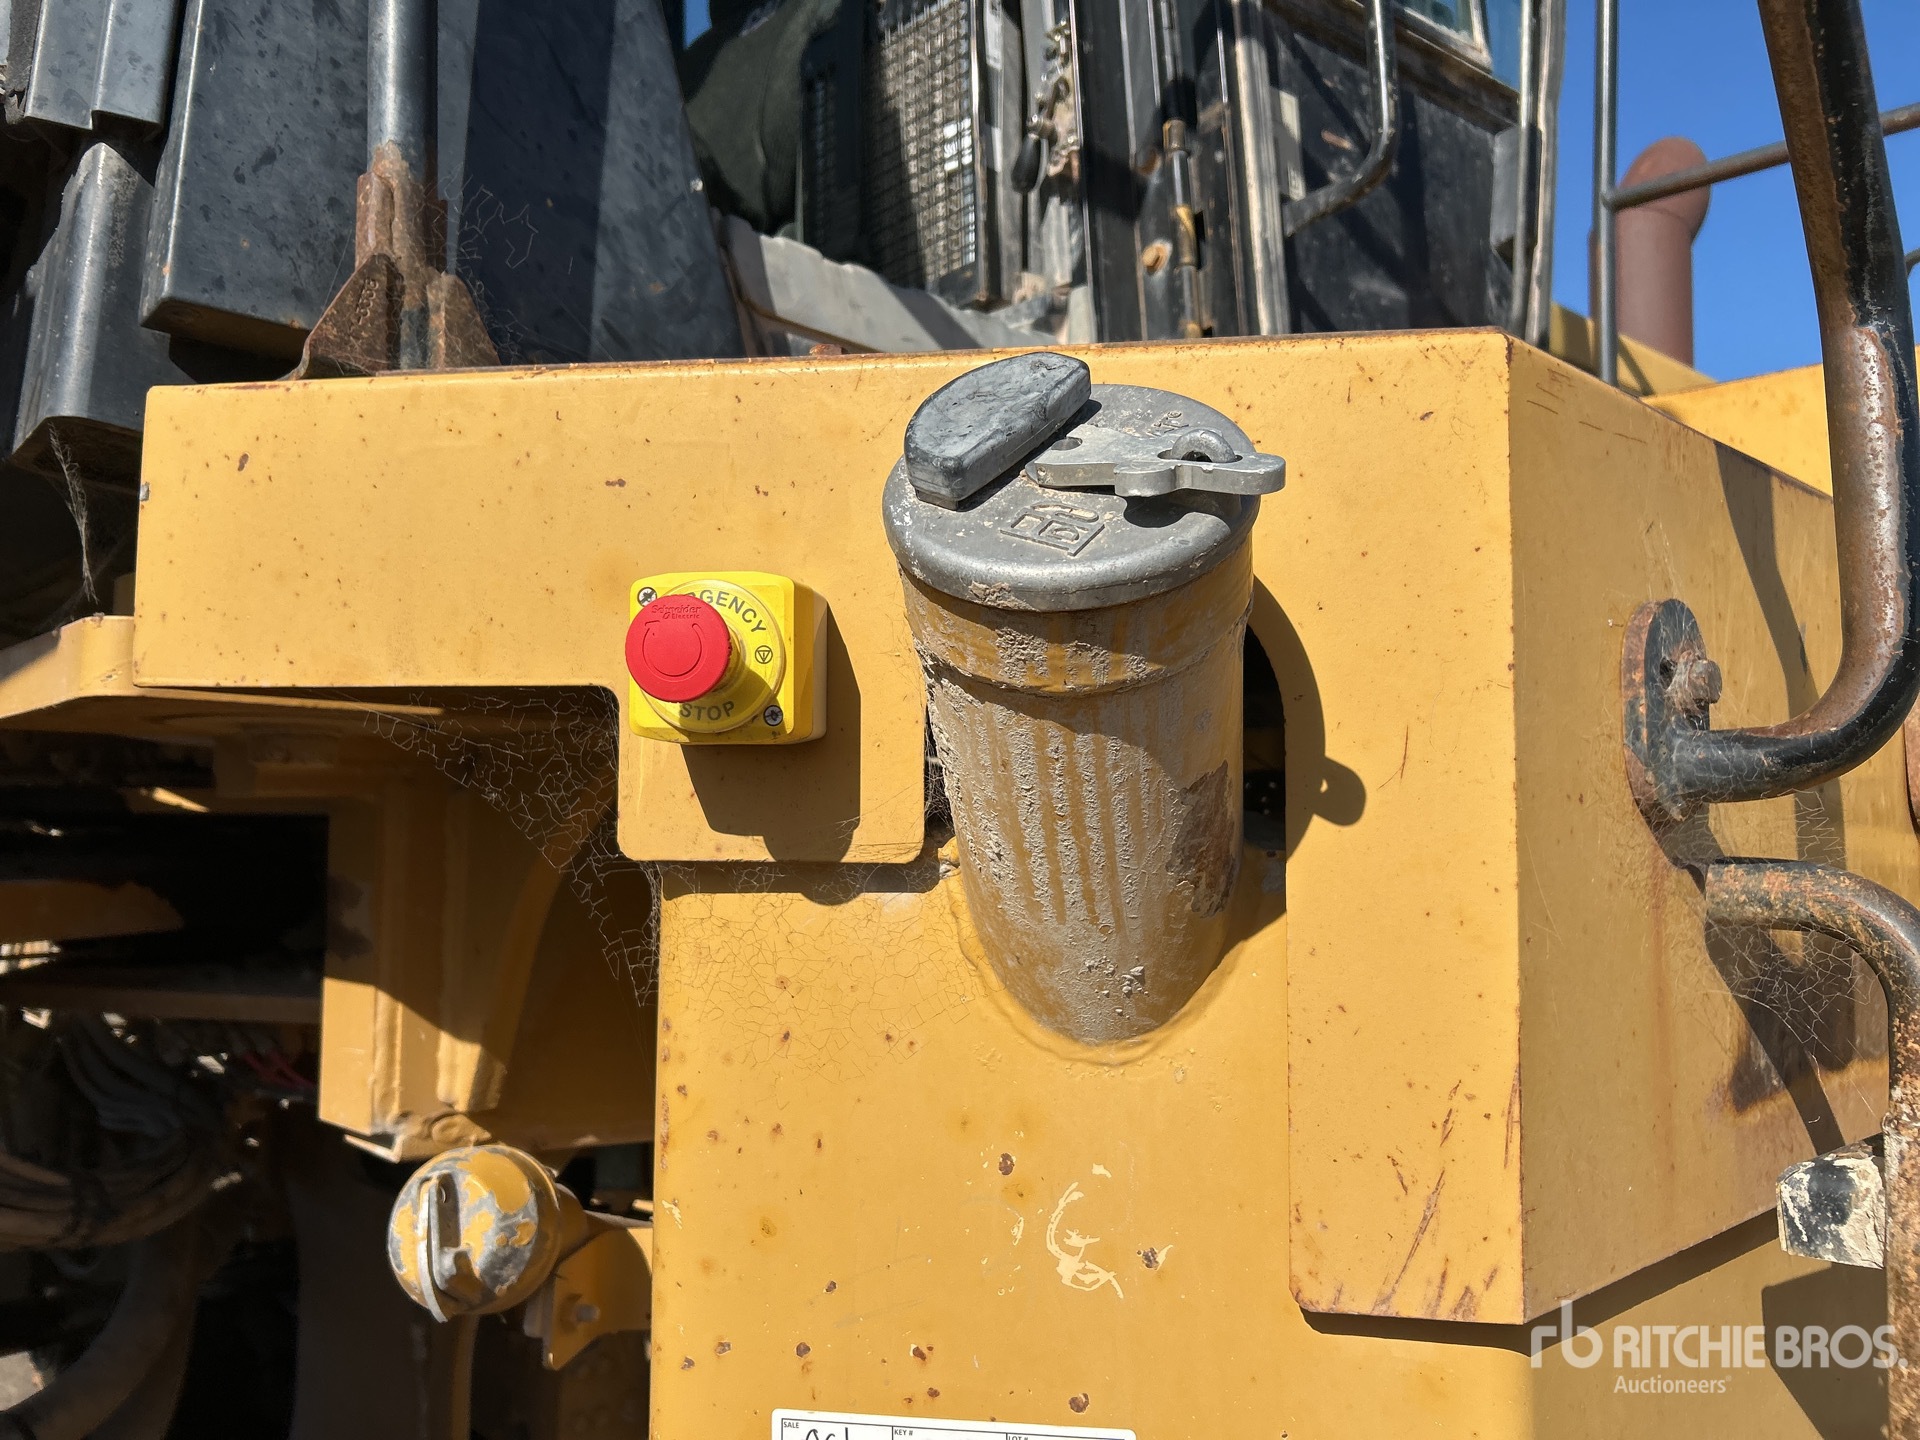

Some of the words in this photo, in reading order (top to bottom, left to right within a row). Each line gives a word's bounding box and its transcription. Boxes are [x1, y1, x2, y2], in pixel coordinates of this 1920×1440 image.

[651, 604, 702, 615] Schneider
[686, 589, 767, 633] GENCY
[679, 700, 735, 721] STOP
[783, 1421, 800, 1429] SALE
